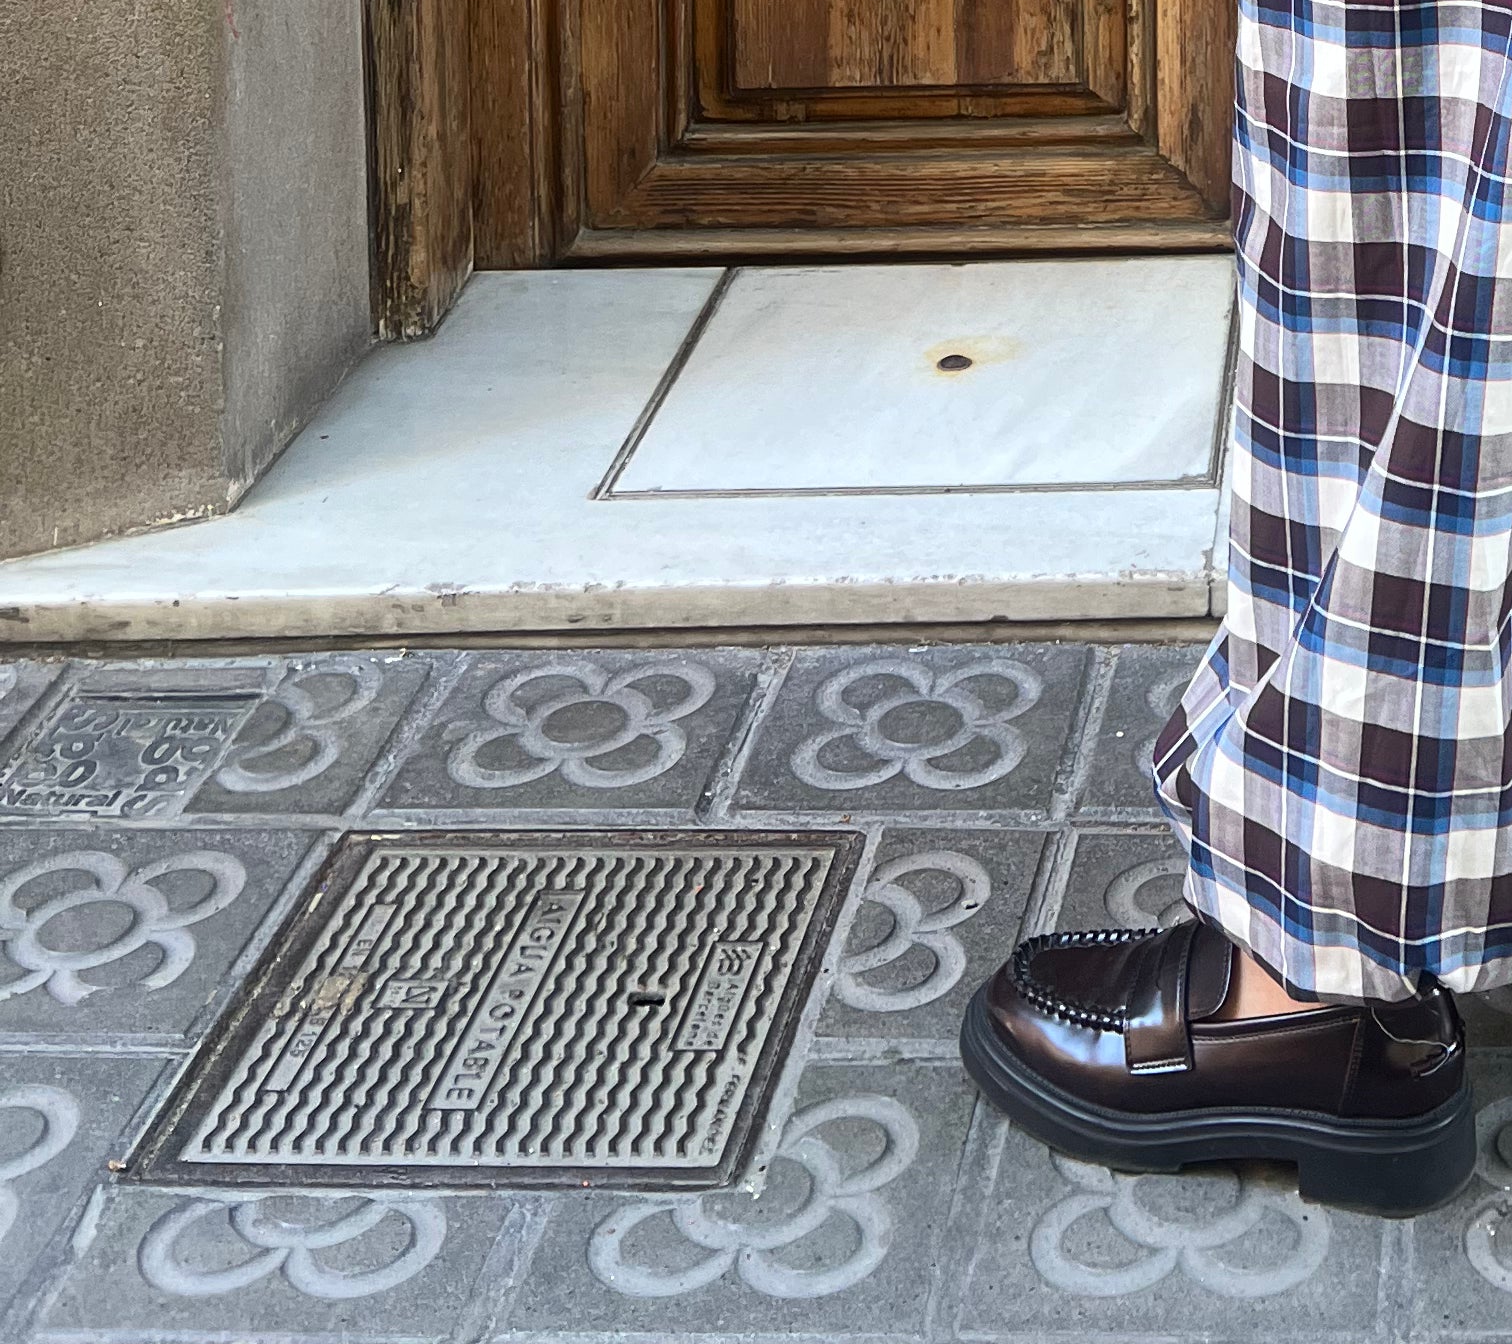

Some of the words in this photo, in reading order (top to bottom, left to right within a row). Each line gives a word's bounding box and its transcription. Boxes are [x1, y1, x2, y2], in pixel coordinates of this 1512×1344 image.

[5, 789, 123, 808] Natural
[510, 902, 568, 977] AIGUA
[288, 1030, 318, 1058] 125
[445, 987, 526, 1101] POTABLE
